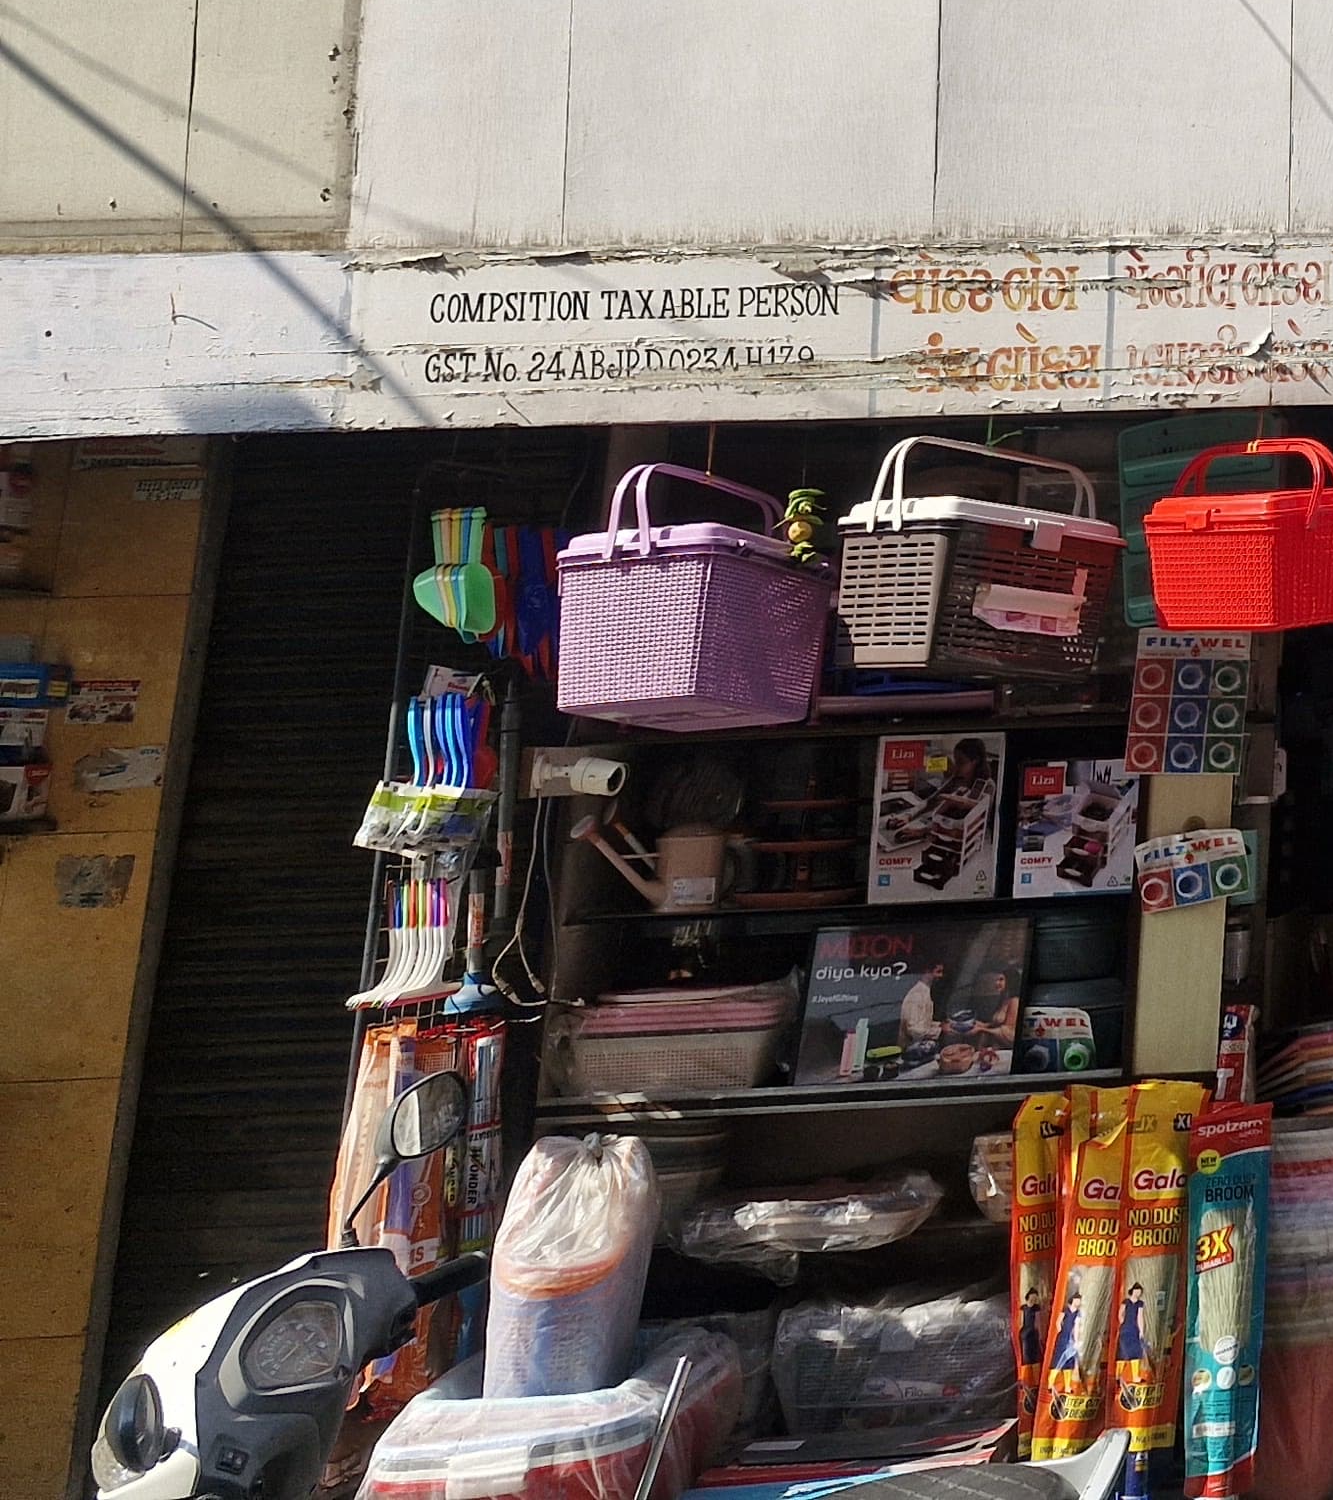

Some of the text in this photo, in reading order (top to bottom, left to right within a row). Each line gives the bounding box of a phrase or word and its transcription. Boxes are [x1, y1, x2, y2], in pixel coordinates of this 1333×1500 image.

[430, 284, 840, 323] COMPSITION TAXABLE PERSON
[425, 352, 477, 383] GST
[891, 750, 915, 759] Liza
[1032, 775, 1055, 786] Liza
[878, 857, 913, 866] COMFY
[1020, 856, 1053, 865] COMFY
[815, 962, 908, 983] diya kya?
[1205, 1185, 1254, 1202] BROOM
[1129, 1208, 1151, 1226] NO
[1075, 1218, 1096, 1235] NO
[1077, 1238, 1118, 1256] BROO
[1196, 1227, 1231, 1261] 3X
